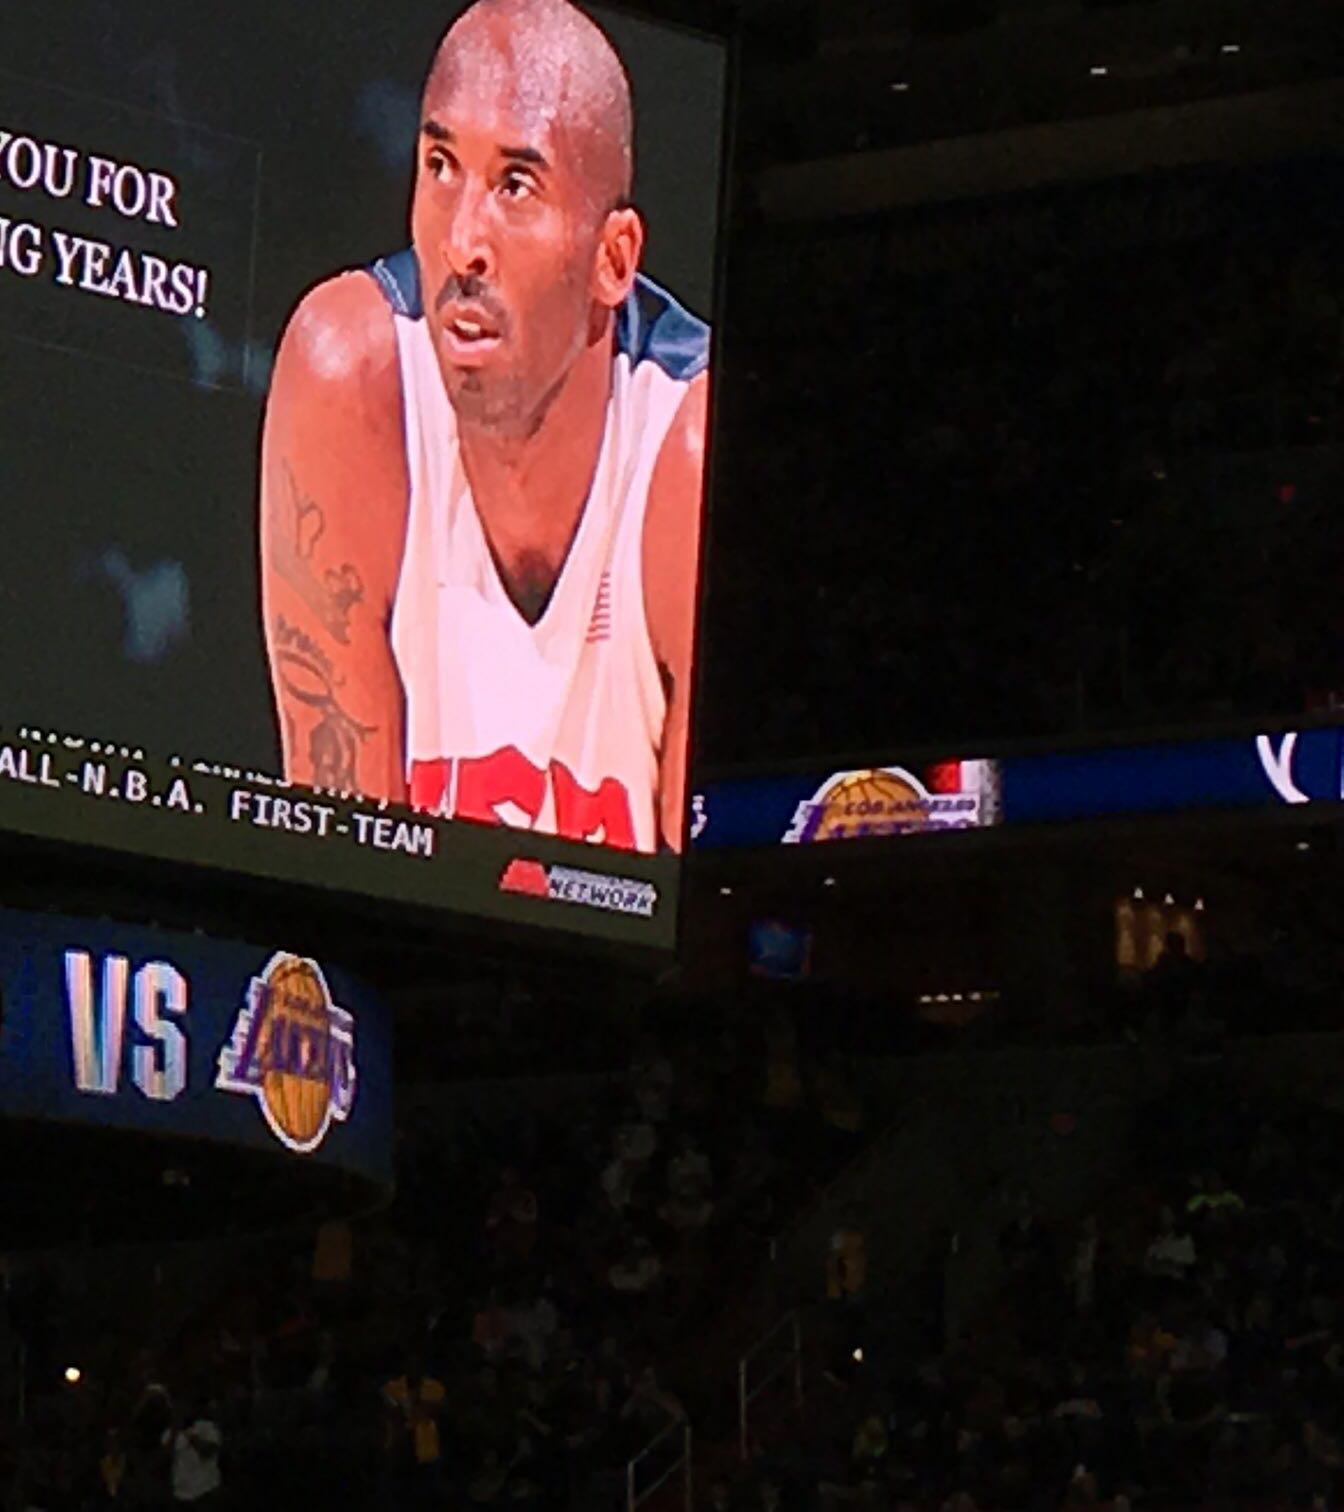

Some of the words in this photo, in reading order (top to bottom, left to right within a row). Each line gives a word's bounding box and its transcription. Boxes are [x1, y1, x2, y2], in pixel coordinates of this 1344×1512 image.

[86, 156, 178, 228] FOR
[52, 232, 207, 318] YEARS!
[231, 790, 434, 857] FIRST-TEAM
[549, 878, 653, 912] NETWORK
[65, 951, 186, 1099] VS
